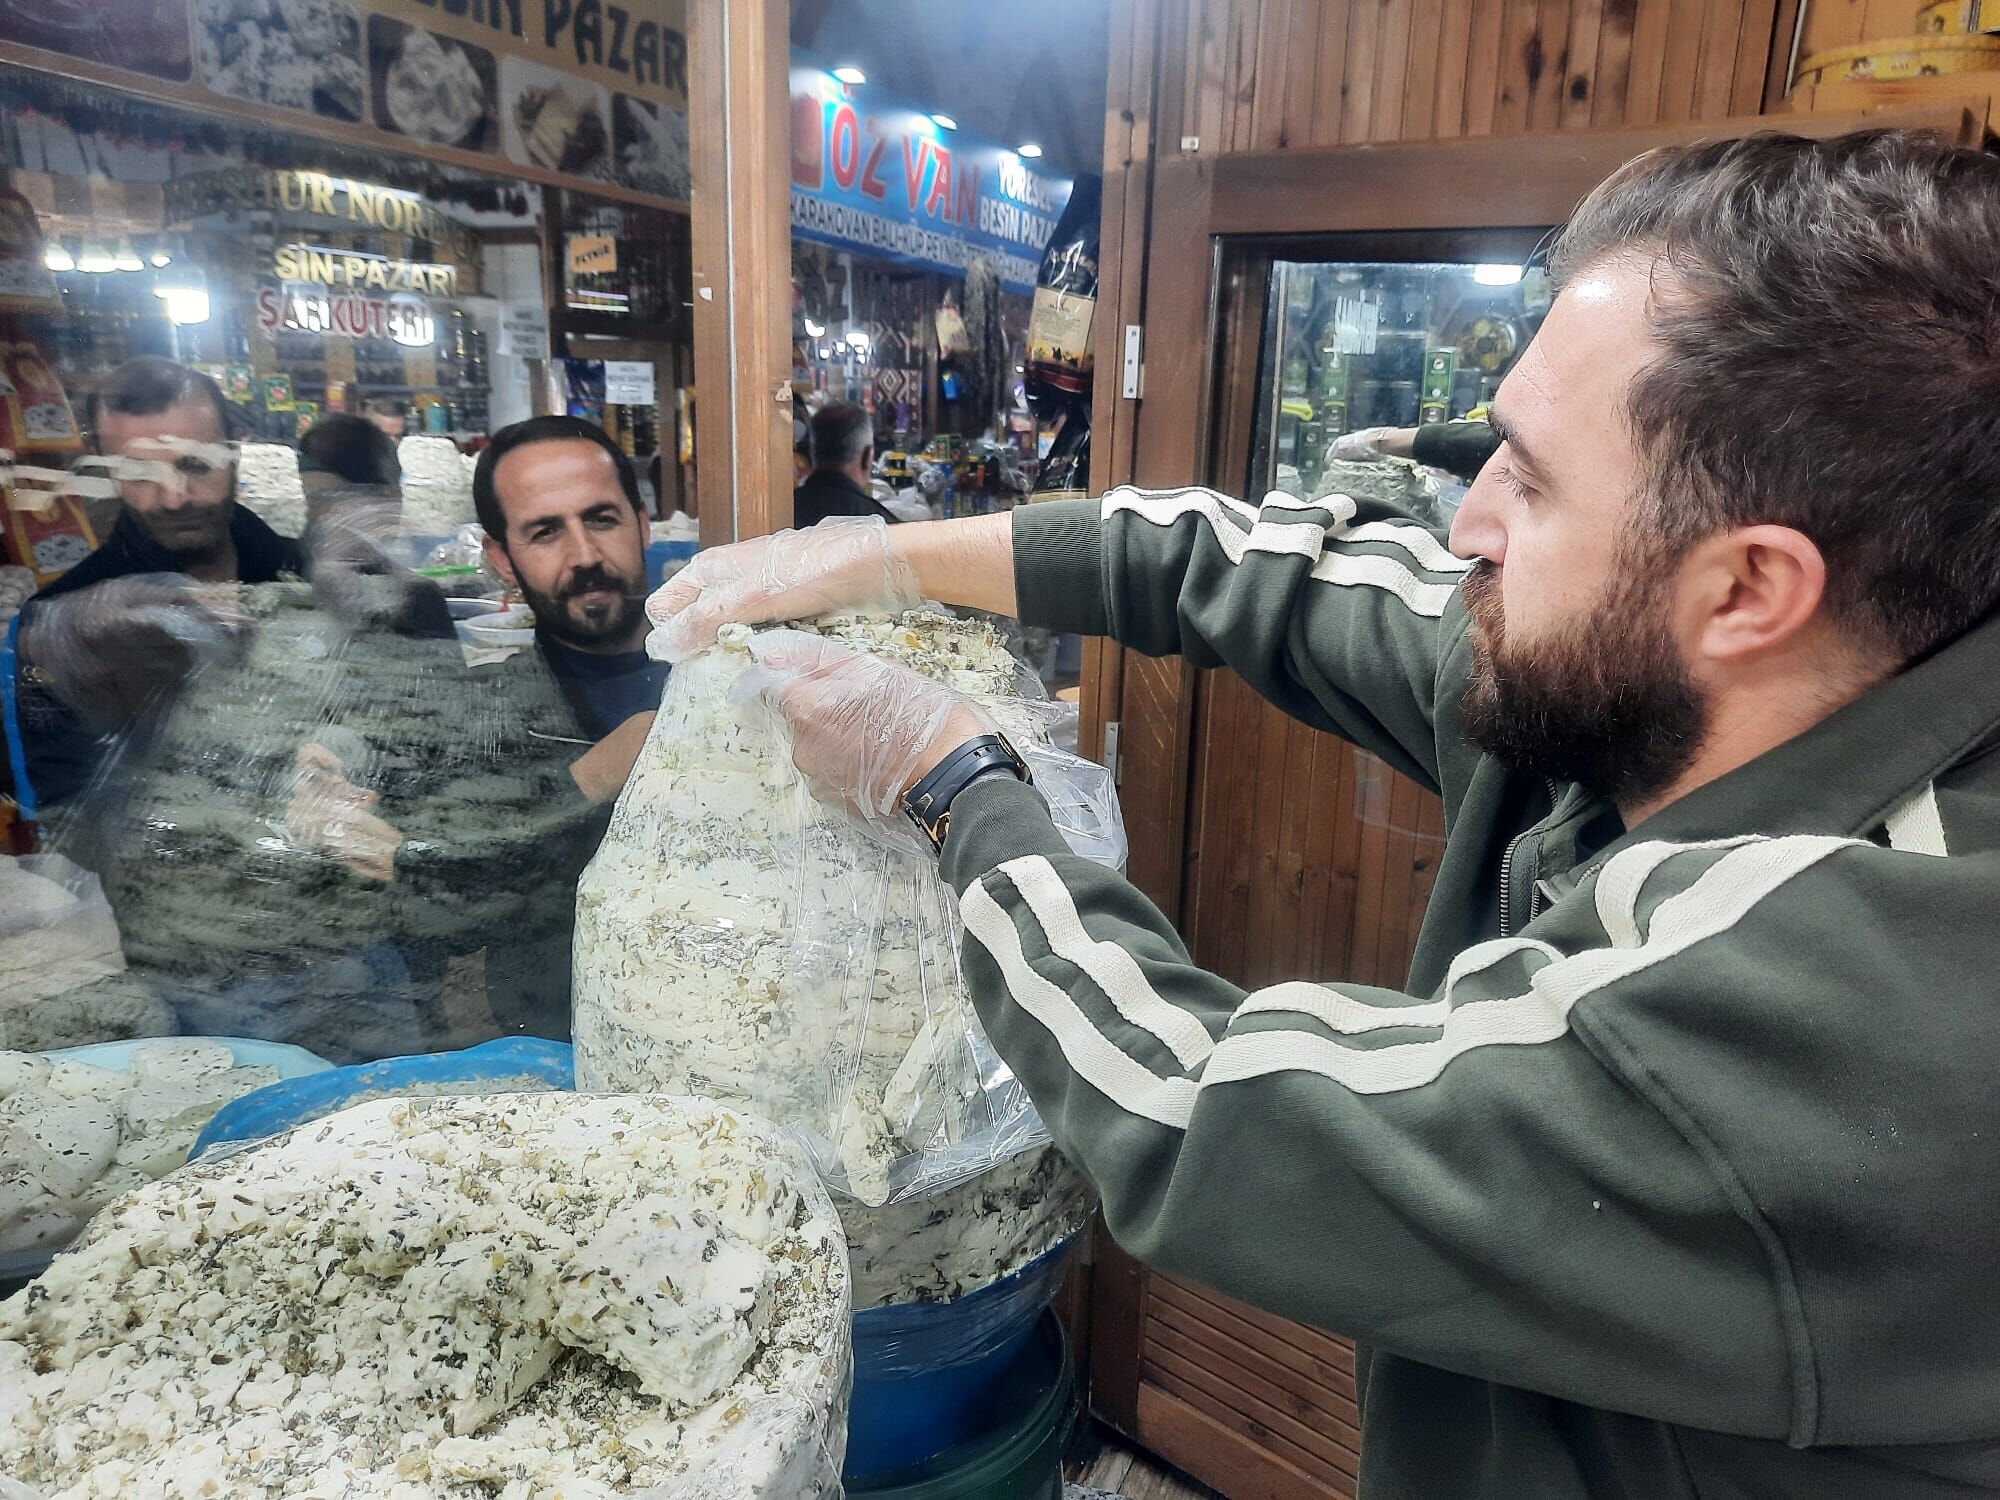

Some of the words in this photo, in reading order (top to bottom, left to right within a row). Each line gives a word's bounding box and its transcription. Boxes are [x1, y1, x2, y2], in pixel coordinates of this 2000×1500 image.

[903, 132, 980, 229] VAN
[980, 195, 1020, 243] BESİN
[1021, 209, 1058, 251] PAZA
